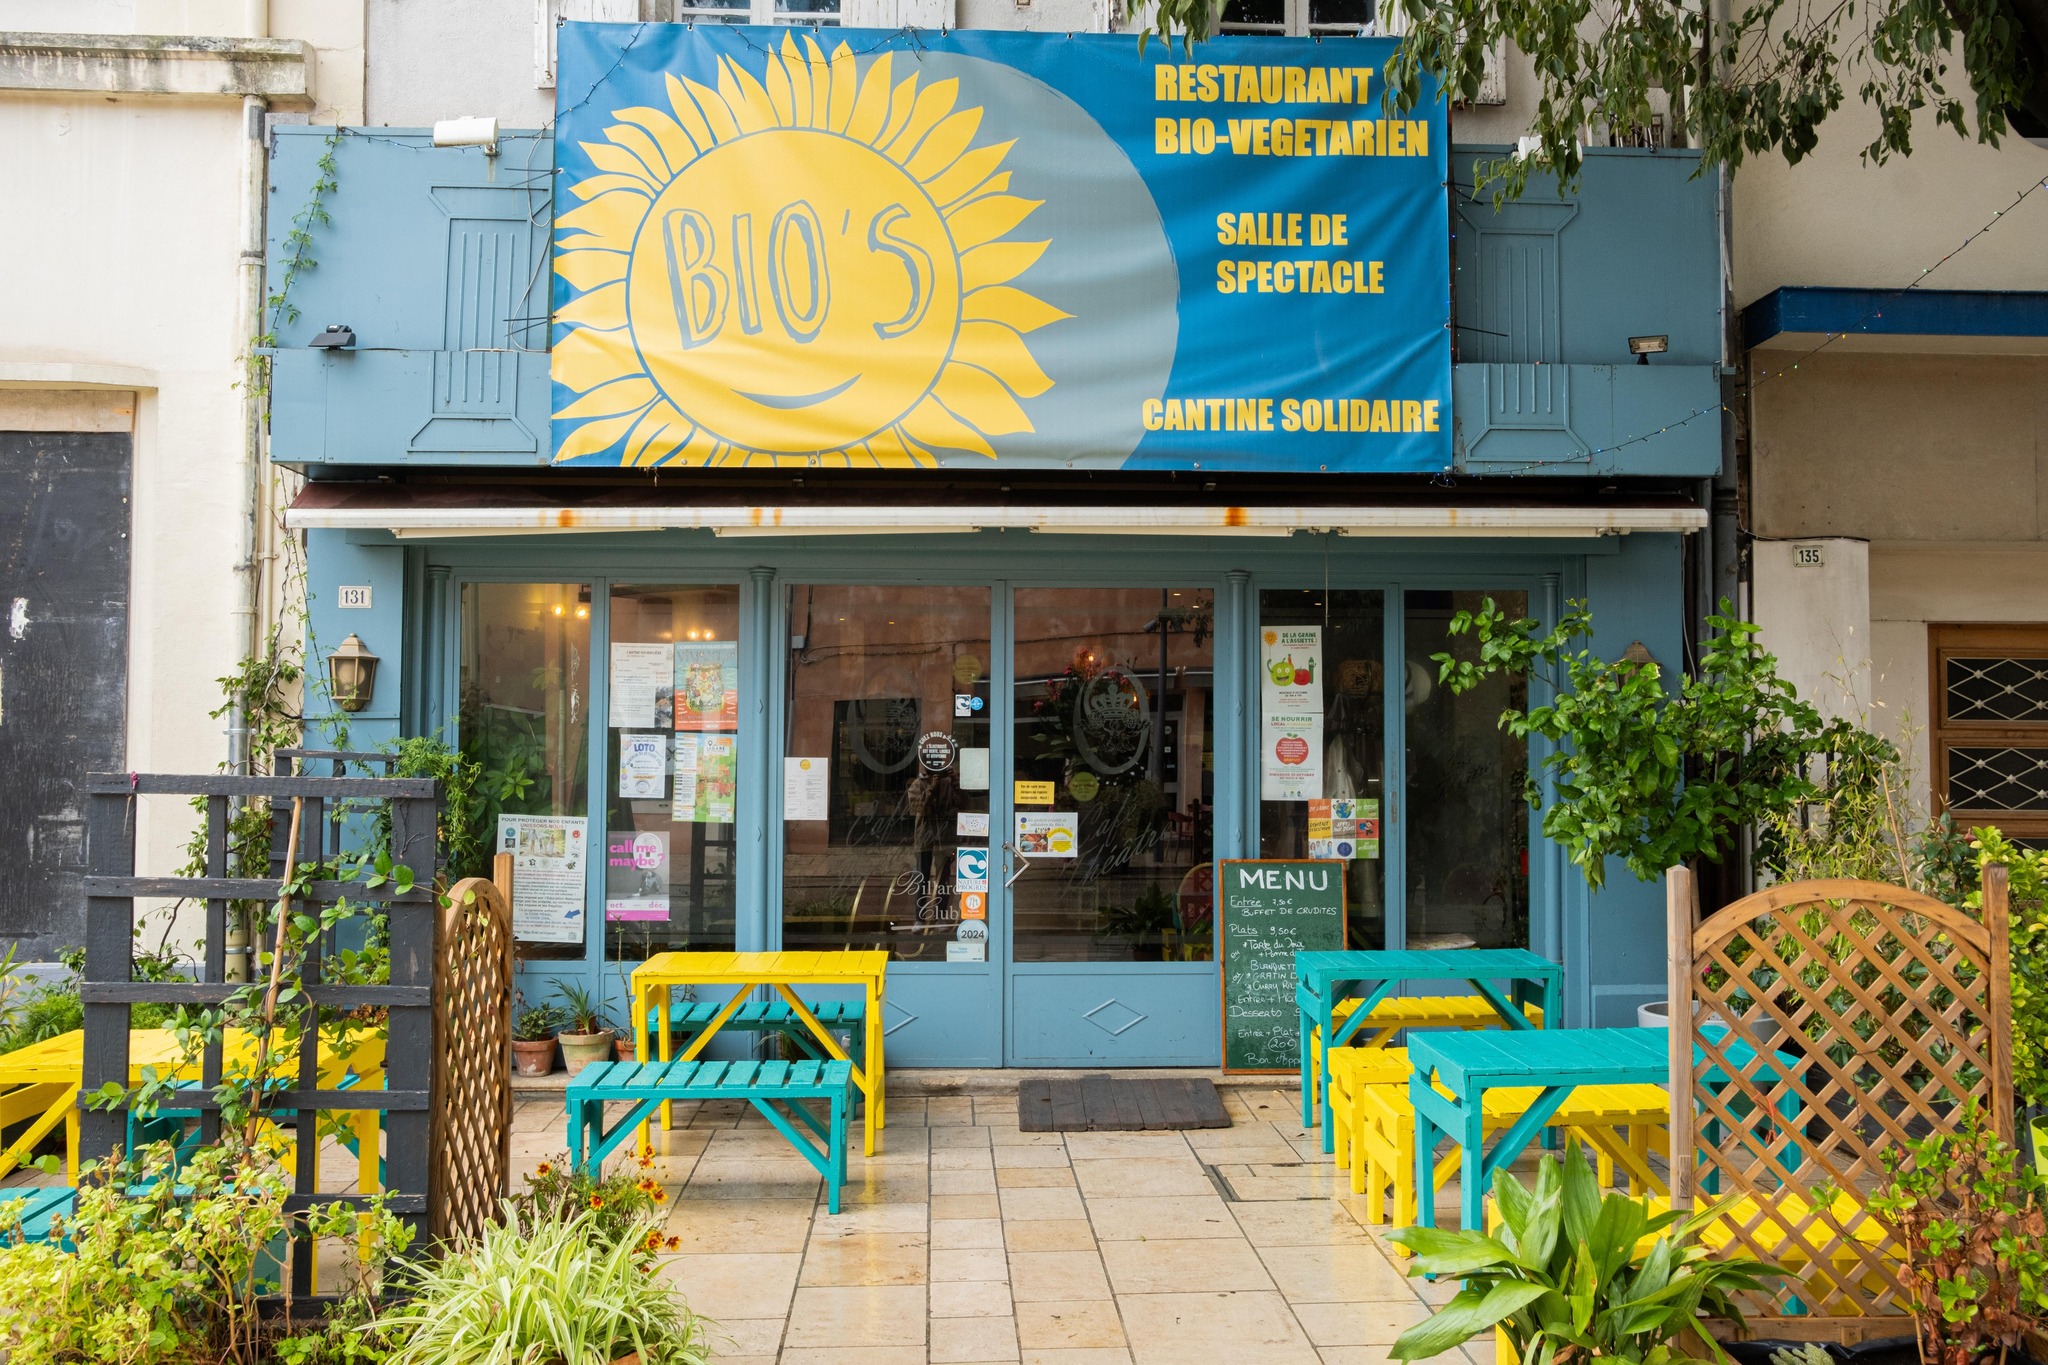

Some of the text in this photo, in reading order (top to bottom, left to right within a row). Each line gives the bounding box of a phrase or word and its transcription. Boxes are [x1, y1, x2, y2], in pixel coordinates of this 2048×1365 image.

[1155, 64, 1374, 104] RESTAURANT
[1155, 117, 1429, 157] BIO-VEGETARIEN
[1216, 212, 1348, 246] SALLE DE
[662, 199, 935, 350] BIO'S
[1216, 259, 1385, 294] SPECTACLE
[1142, 398, 1440, 433] CANTINE SOLIDAIRE
[1798, 549, 1820, 563] 135
[344, 589, 364, 604] 131
[634, 744, 655, 752] LOTO
[609, 840, 656, 853] call me
[609, 854, 655, 872] maybe
[1240, 868, 1328, 891] MENU
[917, 896, 959, 920] Club
[961, 930, 984, 938] 2024
[1272, 1026, 1294, 1036] Plat
[1244, 1053, 1271, 1065] Bon
